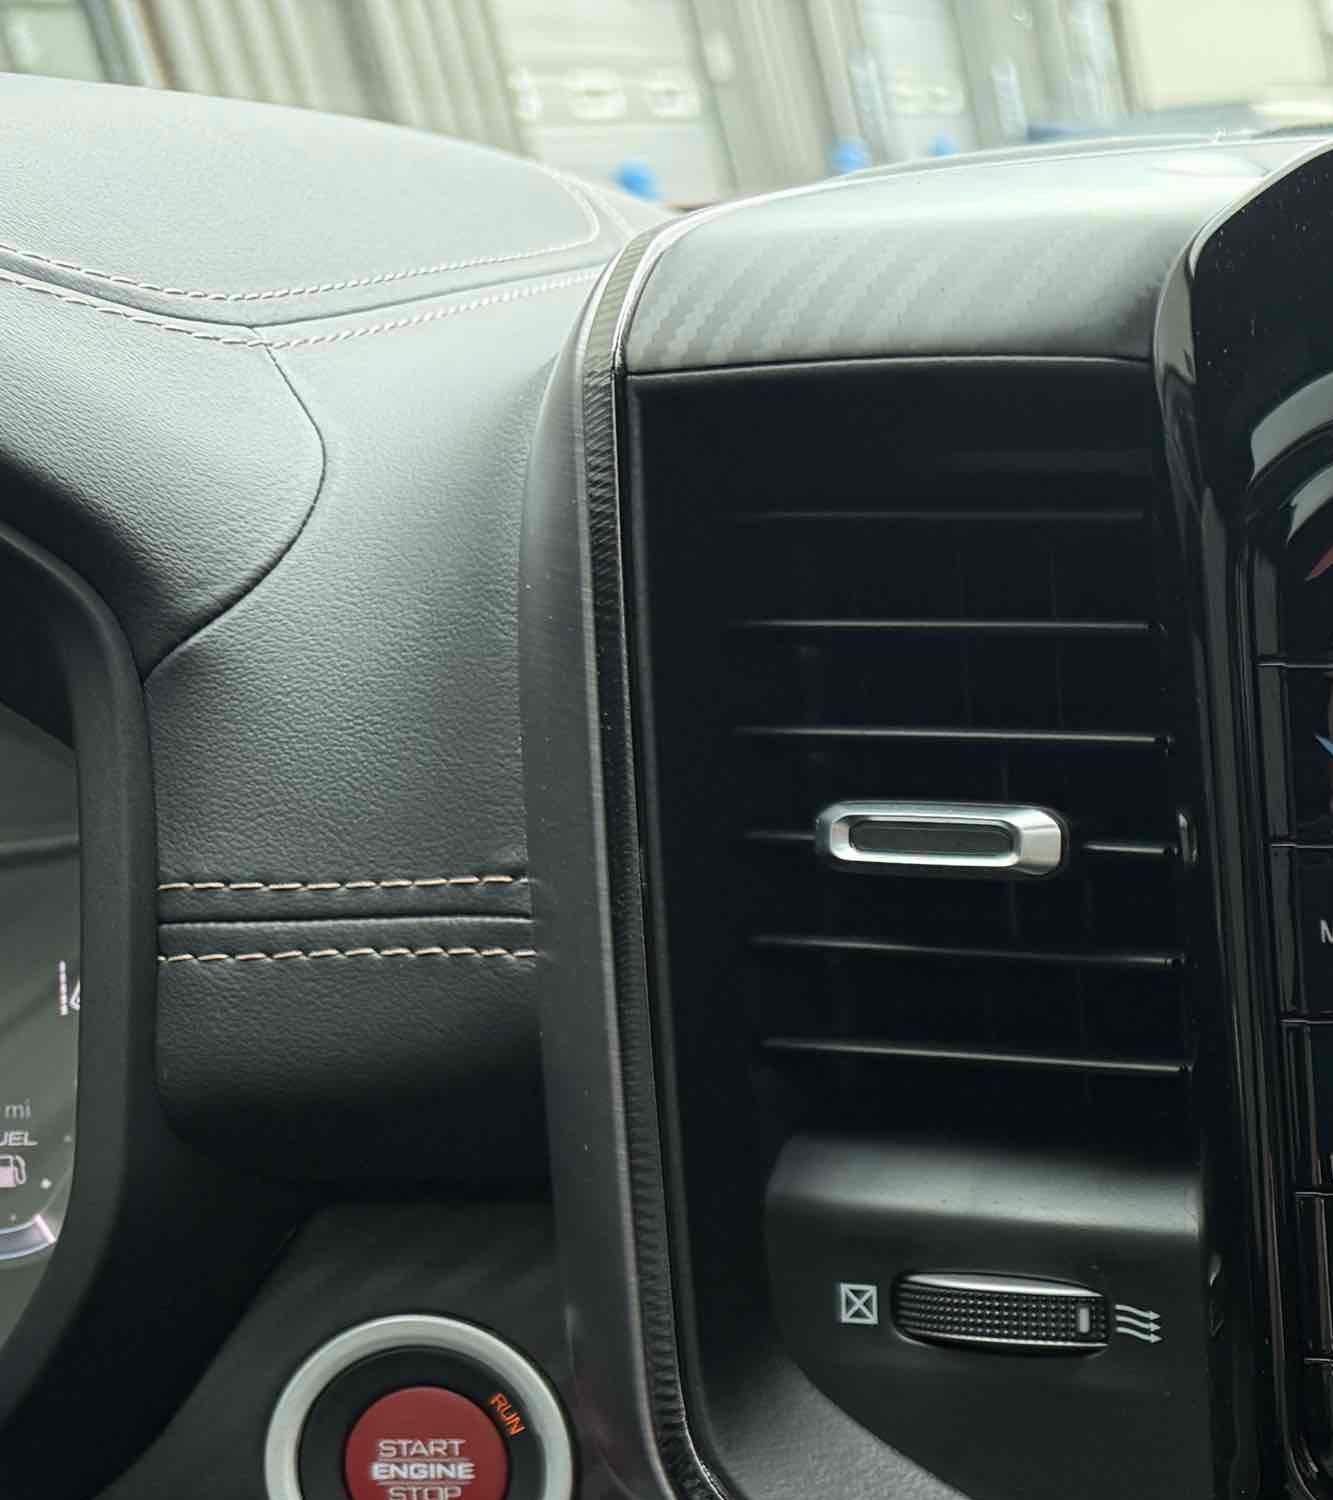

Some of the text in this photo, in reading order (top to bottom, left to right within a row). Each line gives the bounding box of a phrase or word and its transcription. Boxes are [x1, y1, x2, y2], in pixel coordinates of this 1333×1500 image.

[0, 1131, 38, 1146] UEL
[489, 1393, 525, 1436] RUN
[378, 1438, 464, 1458] START
[371, 1462, 475, 1480] ENGINE
